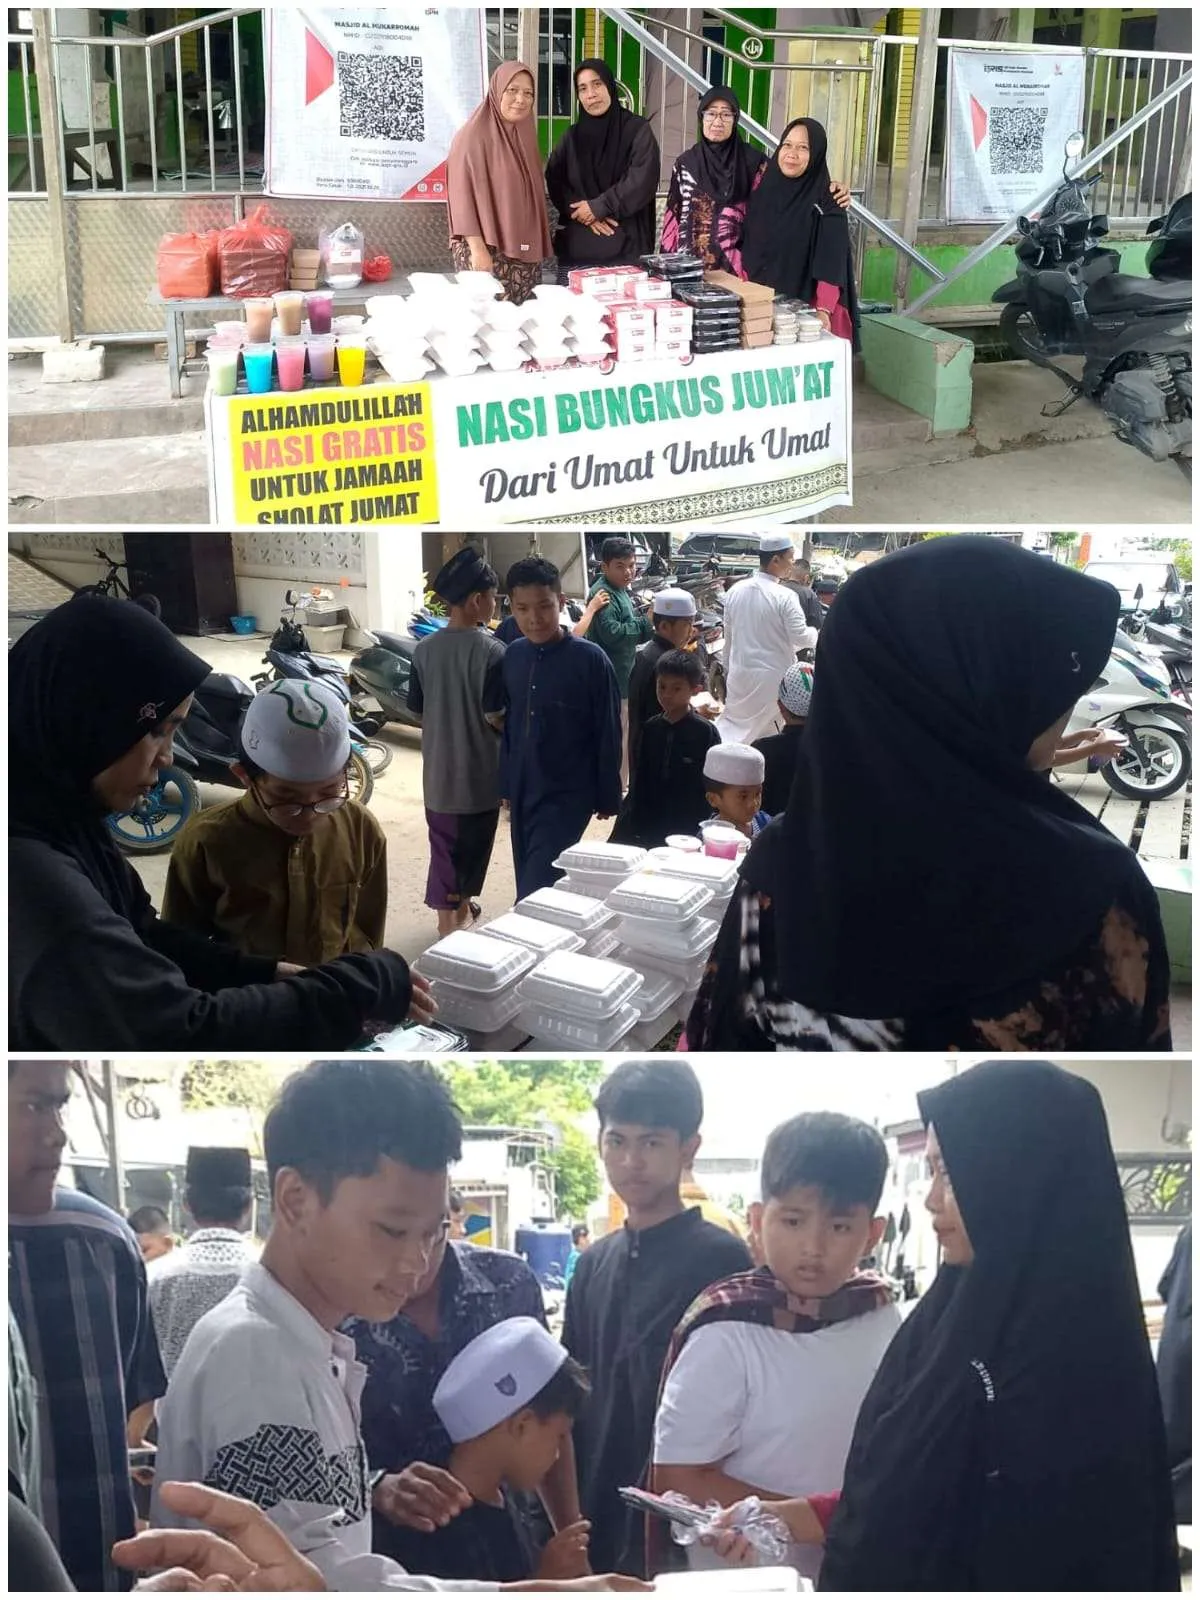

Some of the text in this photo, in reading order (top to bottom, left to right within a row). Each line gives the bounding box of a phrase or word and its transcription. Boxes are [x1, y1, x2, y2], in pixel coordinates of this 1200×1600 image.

[361, 21, 370, 29] AL
[241, 392, 423, 434] ALHAMDULILLAH
[456, 361, 835, 448] NASI BUNGKUS JUM'AT
[242, 422, 427, 472] NASI GRATIS
[479, 422, 832, 504] Dari Umat Untuk Umat
[250, 458, 423, 502] UNTUK JAMAAH
[350, 492, 420, 523] JUMAT
